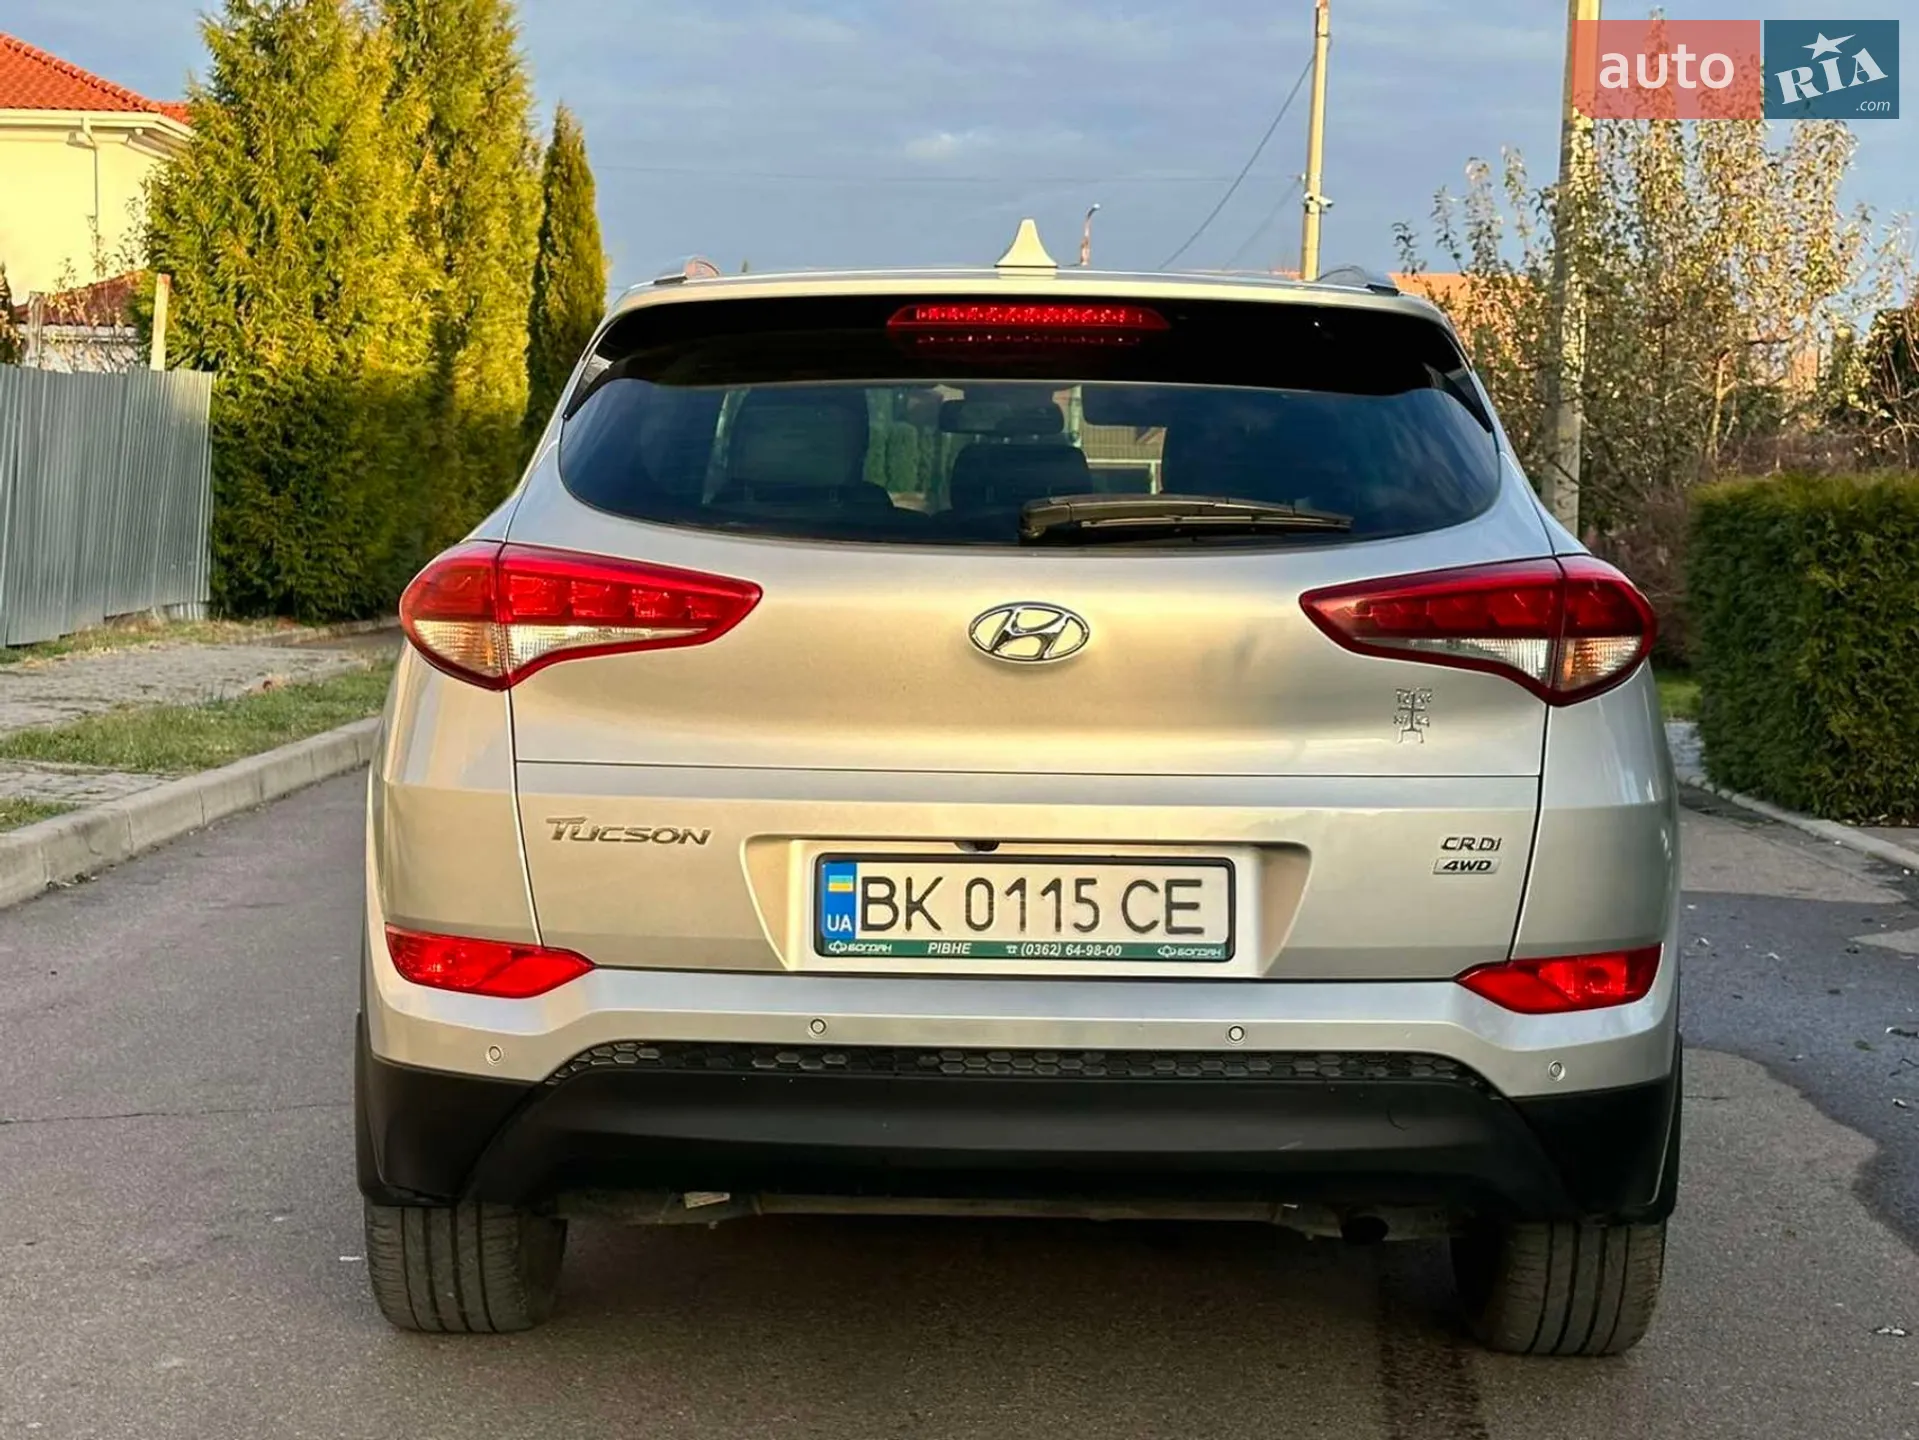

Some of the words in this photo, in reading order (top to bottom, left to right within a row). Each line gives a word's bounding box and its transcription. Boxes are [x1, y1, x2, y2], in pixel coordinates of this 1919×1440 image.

[1443, 860, 1493, 872] 4WD
[861, 876, 943, 931] BK
[965, 877, 1100, 933] 0115
[1121, 878, 1204, 935] CE
[827, 914, 852, 932] UA
[1020, 944, 1062, 956] (0362)
[1065, 944, 1123, 957] 64-98-00
